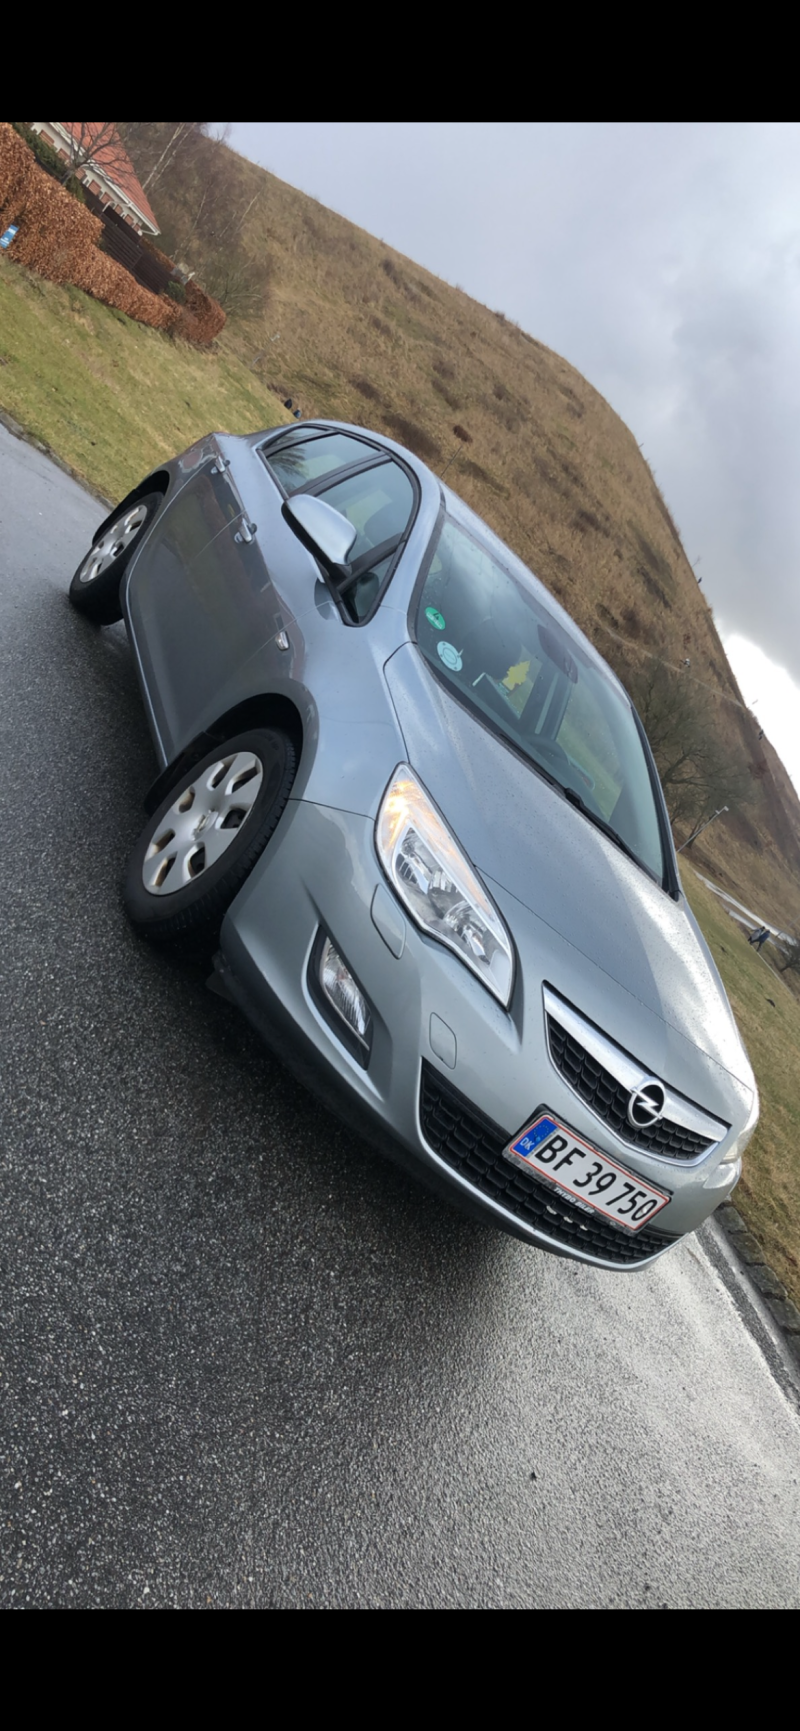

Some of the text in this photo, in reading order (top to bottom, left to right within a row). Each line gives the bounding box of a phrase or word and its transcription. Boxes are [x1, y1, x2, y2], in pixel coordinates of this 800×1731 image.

[519, 1137, 535, 1151] DK
[534, 1134, 658, 1222] BF 39 750
